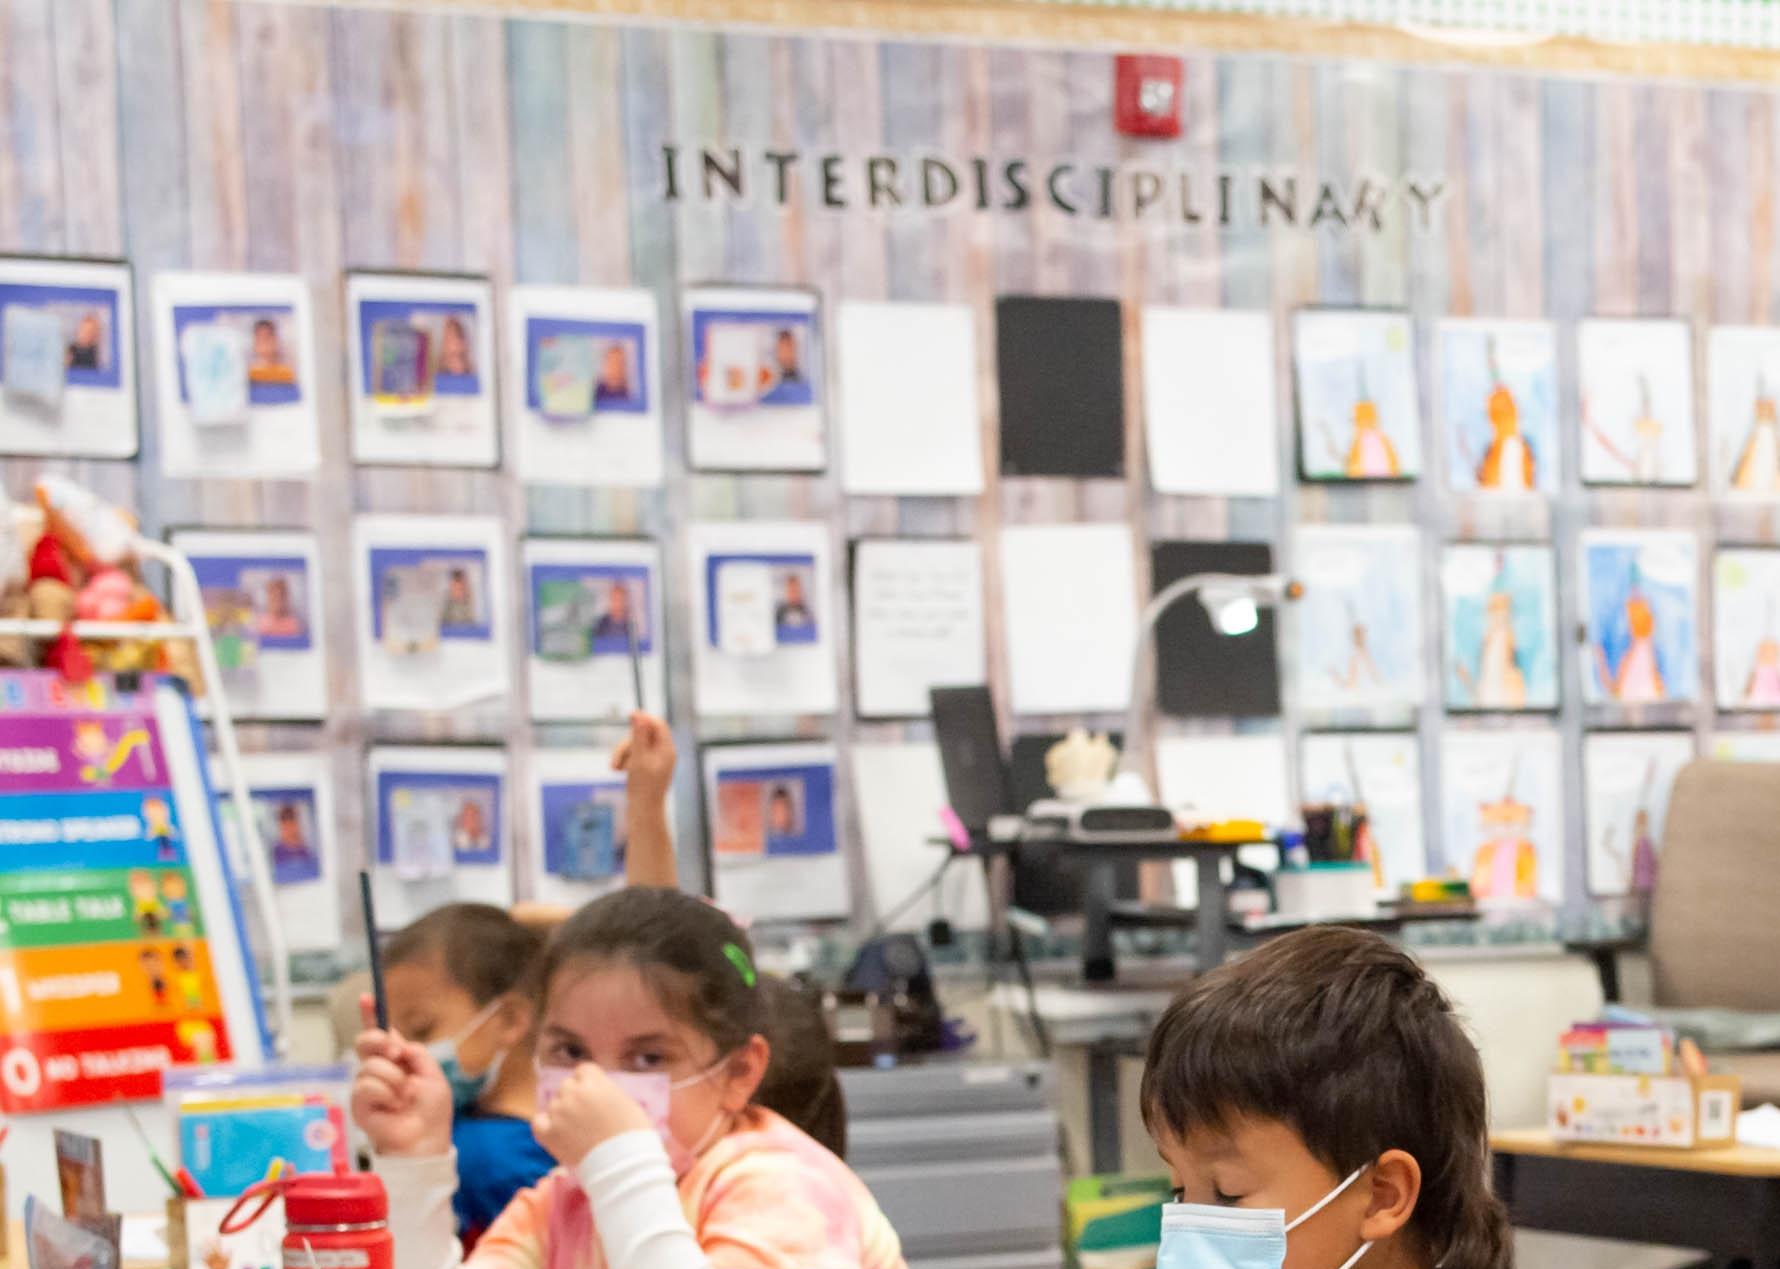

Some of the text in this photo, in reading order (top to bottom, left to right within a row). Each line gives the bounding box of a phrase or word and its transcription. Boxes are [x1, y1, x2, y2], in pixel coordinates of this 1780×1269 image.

[661, 143, 1443, 233] INTERDISCIPLINARY
[1, 1047, 42, 1096] 0
[45, 1055, 79, 1082] NO
